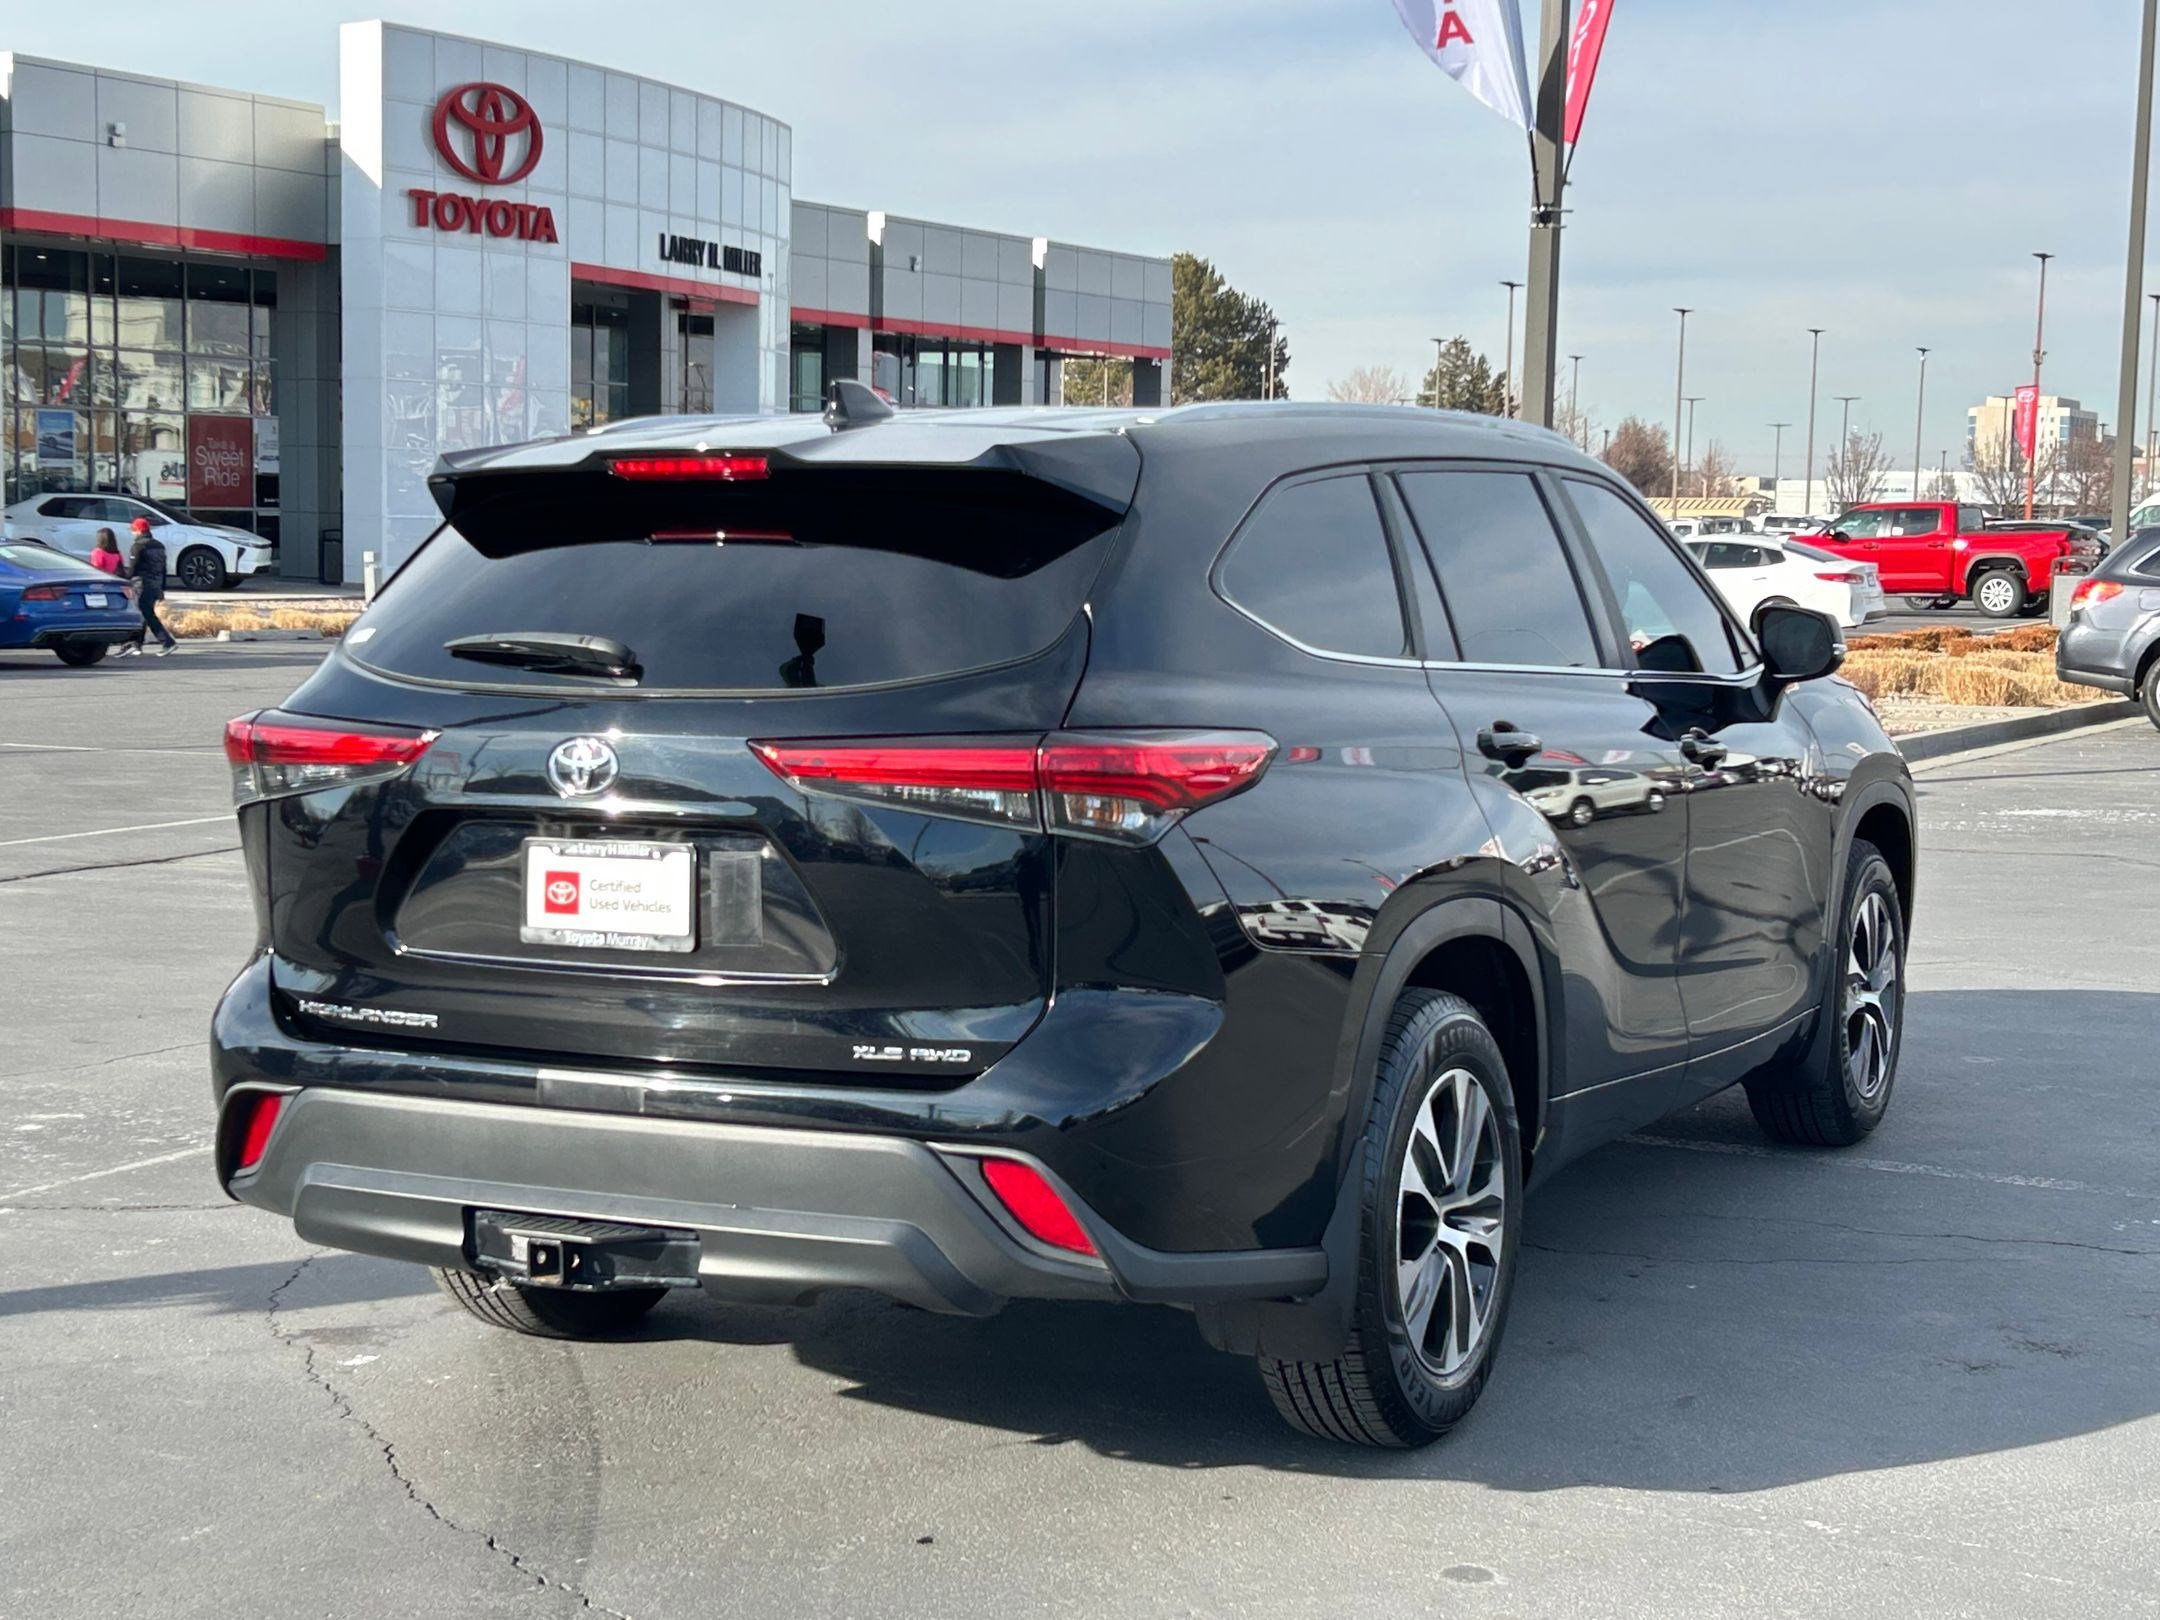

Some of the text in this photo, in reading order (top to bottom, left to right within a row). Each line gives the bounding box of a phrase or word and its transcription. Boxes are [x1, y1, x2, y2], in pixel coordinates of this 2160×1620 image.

[408, 189, 558, 243] TOYOTA
[659, 233, 706, 266] LARRY
[723, 244, 762, 278] MILLER
[196, 445, 244, 467] Sweet
[204, 467, 241, 487] Ride
[577, 842, 606, 857] Larry
[618, 843, 652, 857] Miller
[590, 879, 642, 894] Certified
[589, 898, 672, 914] Used Vehicles
[565, 932, 649, 950] Toyota Murray
[299, 1000, 438, 1028] HIGHLANDER
[853, 1045, 972, 1062] XLE AWD
